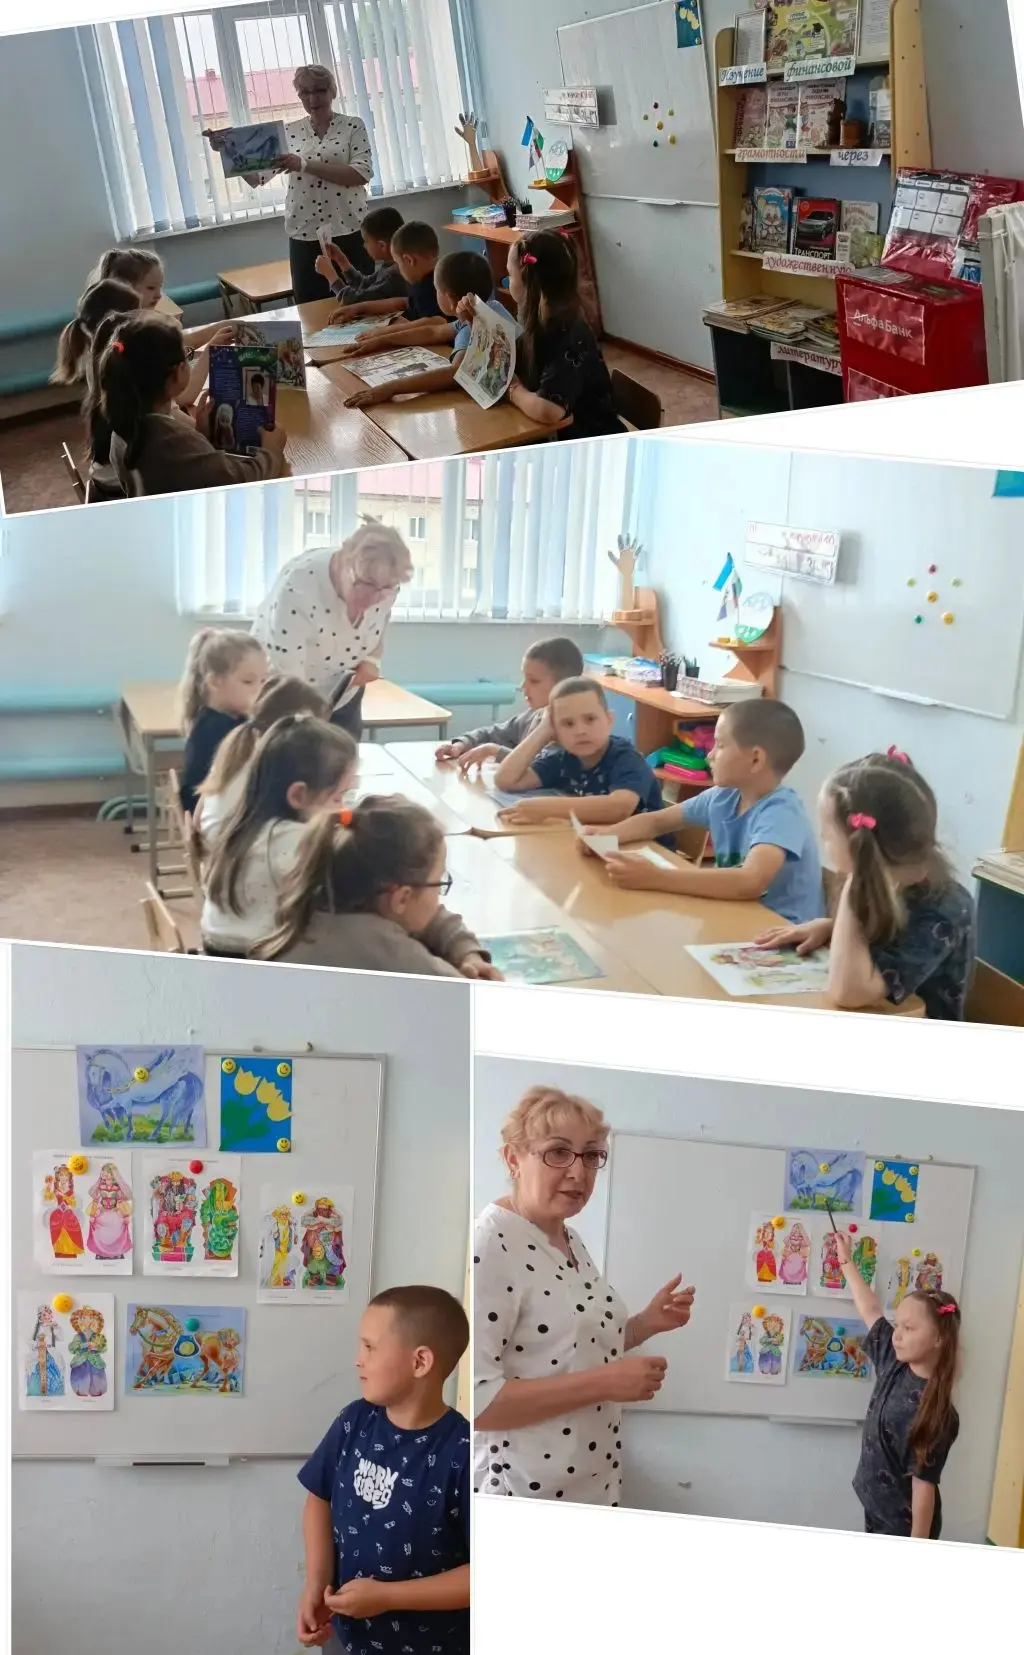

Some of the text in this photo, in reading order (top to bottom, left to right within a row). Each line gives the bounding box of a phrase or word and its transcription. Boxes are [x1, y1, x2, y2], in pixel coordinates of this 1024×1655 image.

[786, 58, 852, 82] финансовой
[737, 149, 806, 161] грамотности
[838, 151, 868, 165] через
[794, 248, 832, 260] ТРАНСПОРТ
[764, 256, 852, 274] художественную
